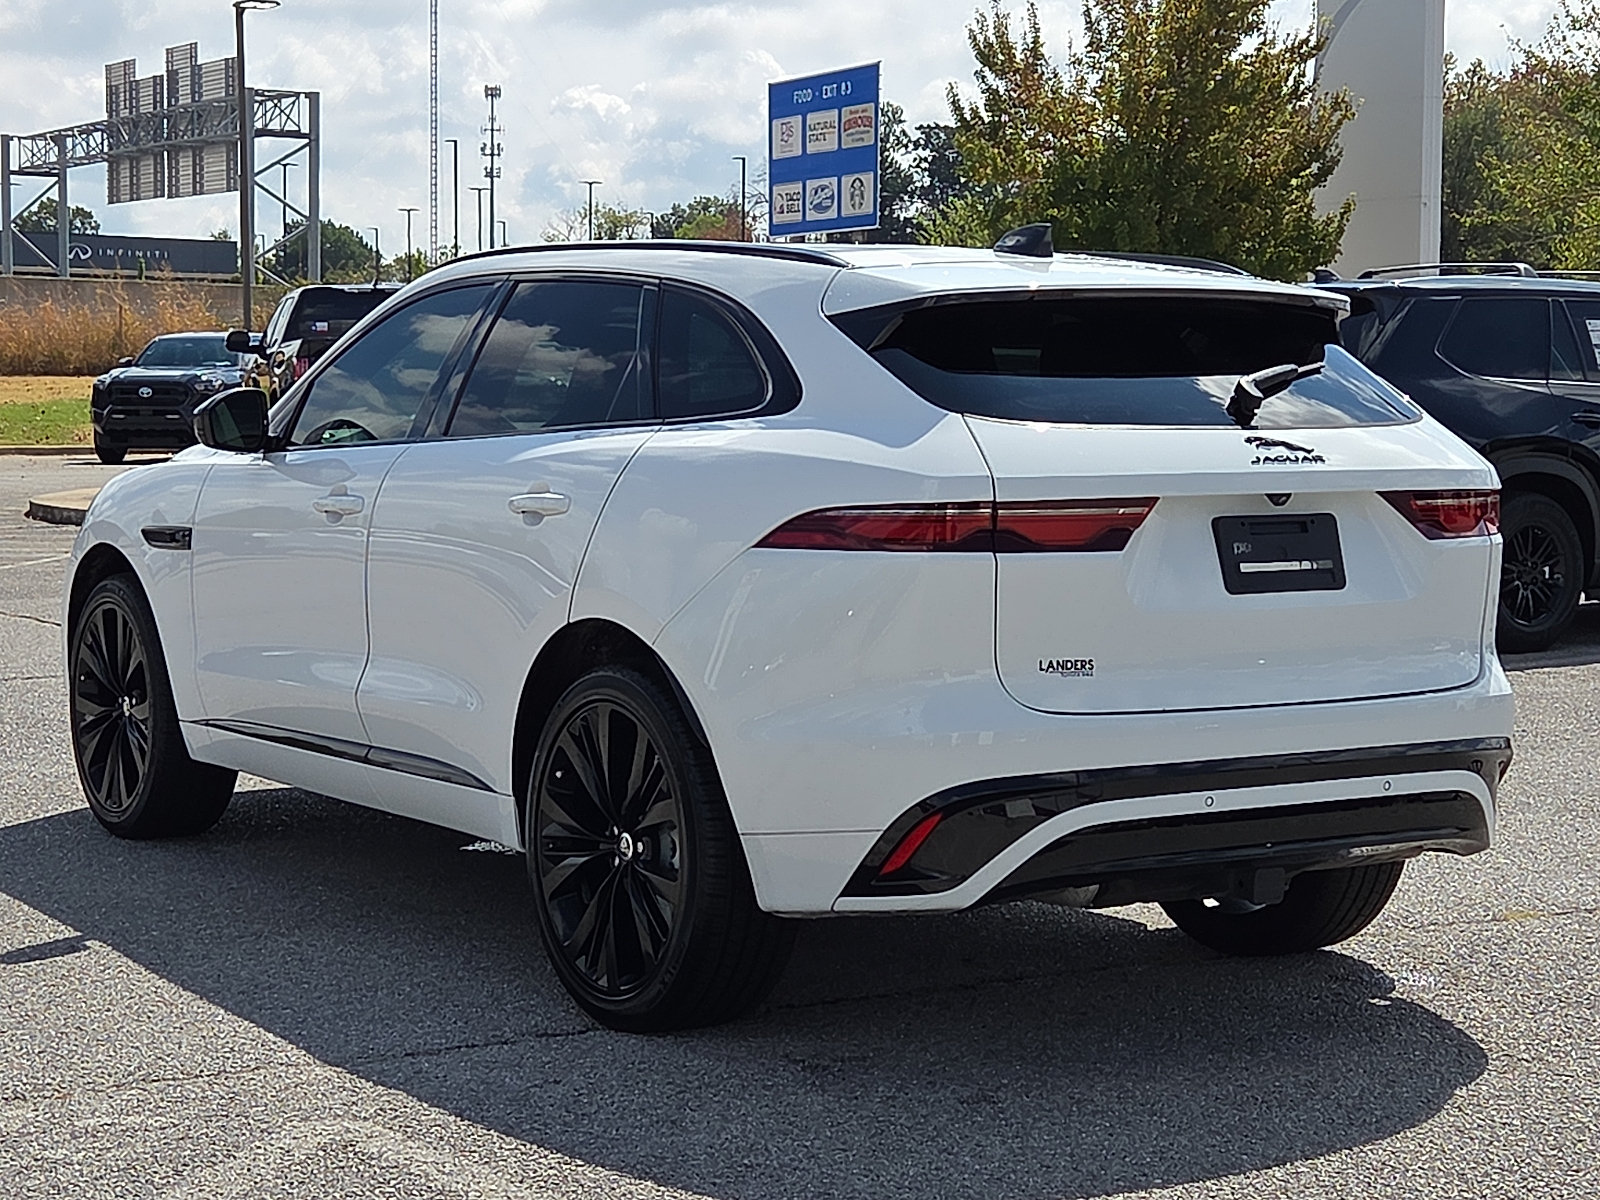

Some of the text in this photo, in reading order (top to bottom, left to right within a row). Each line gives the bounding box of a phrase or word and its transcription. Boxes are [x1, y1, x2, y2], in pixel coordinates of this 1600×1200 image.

[793, 88, 813, 104] FOOD
[822, 84, 837, 98] EXIT
[808, 120, 836, 132] NATURAL
[808, 132, 827, 143] STATE
[785, 191, 801, 202] TACO
[785, 203, 801, 214] BELL
[99, 249, 168, 259] INFINITI
[1251, 455, 1326, 465] JAGUAR
[1039, 659, 1095, 673] LANDERS
